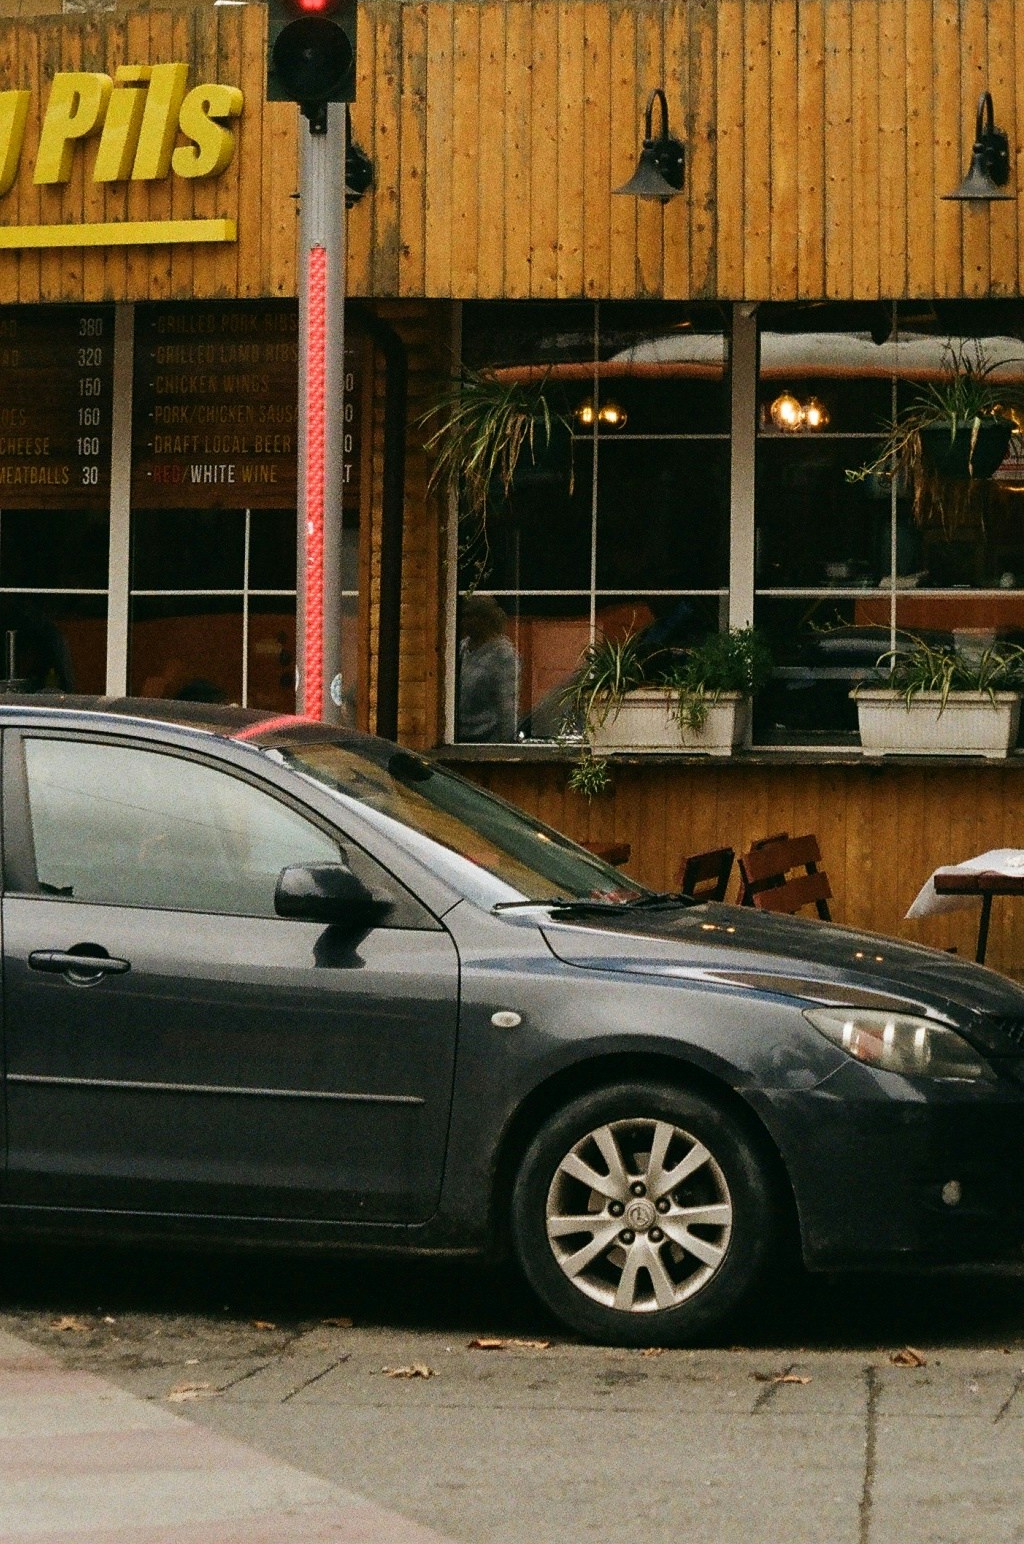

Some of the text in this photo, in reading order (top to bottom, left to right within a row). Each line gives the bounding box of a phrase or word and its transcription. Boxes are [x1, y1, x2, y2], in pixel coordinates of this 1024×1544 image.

[33, 62, 244, 184] Pils
[79, 318, 102, 336] 380
[78, 348, 102, 366] 320
[79, 377, 100, 396] 150
[78, 407, 100, 426] 160
[77, 437, 99, 456] 160
[204, 434, 249, 454] LOCAL
[255, 434, 291, 453] BEER
[82, 466, 98, 485] 30
[240, 464, 278, 483] WINE
